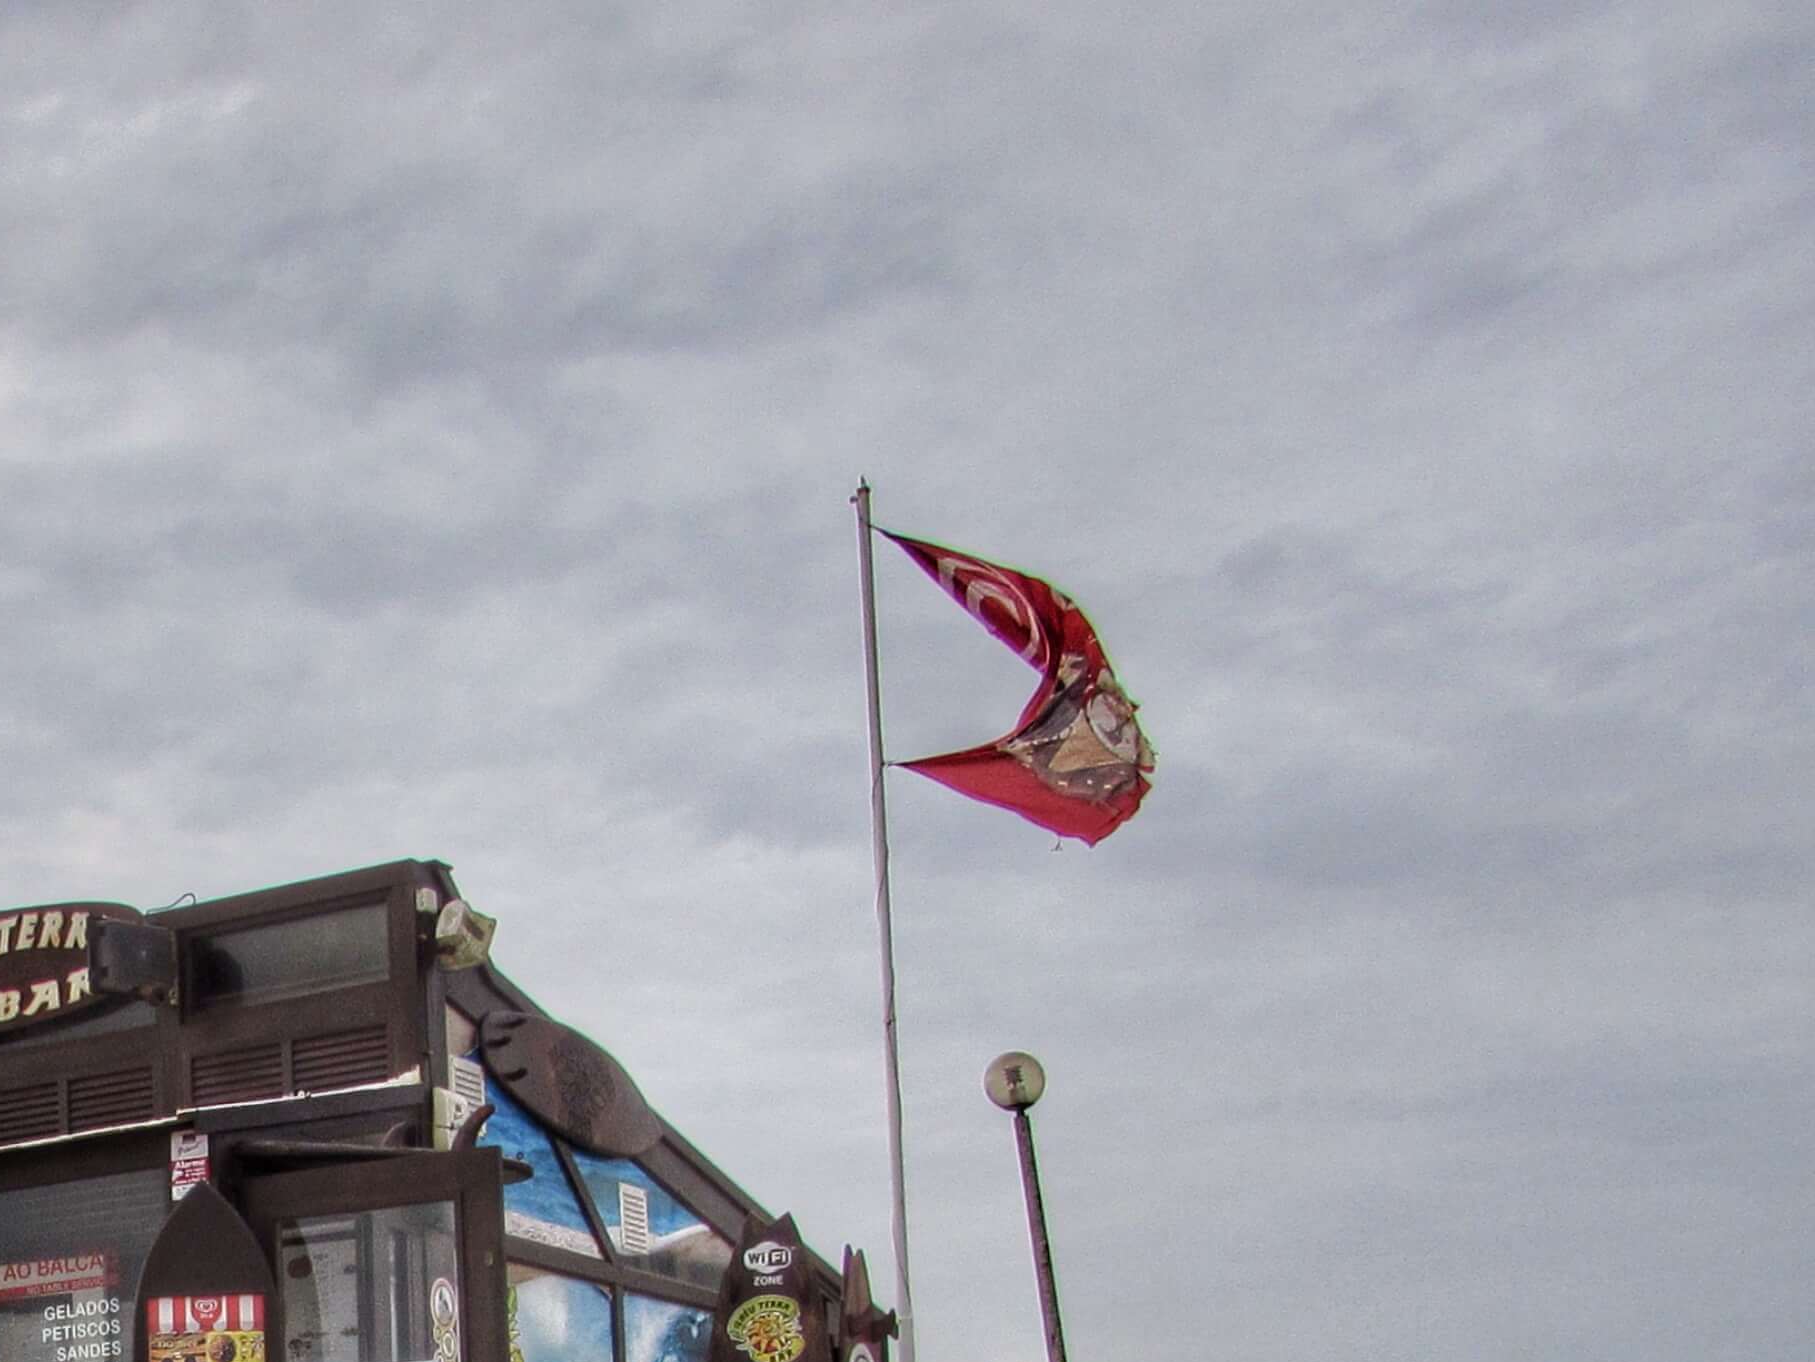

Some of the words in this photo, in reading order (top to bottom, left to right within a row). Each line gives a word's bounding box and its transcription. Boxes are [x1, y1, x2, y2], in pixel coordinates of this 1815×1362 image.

[4, 1263, 31, 1281] AO
[753, 1275, 784, 1287] ZONE
[44, 1298, 120, 1321] GELADOS
[42, 1319, 121, 1343] PETISCOS
[56, 1341, 122, 1362] SANDES
